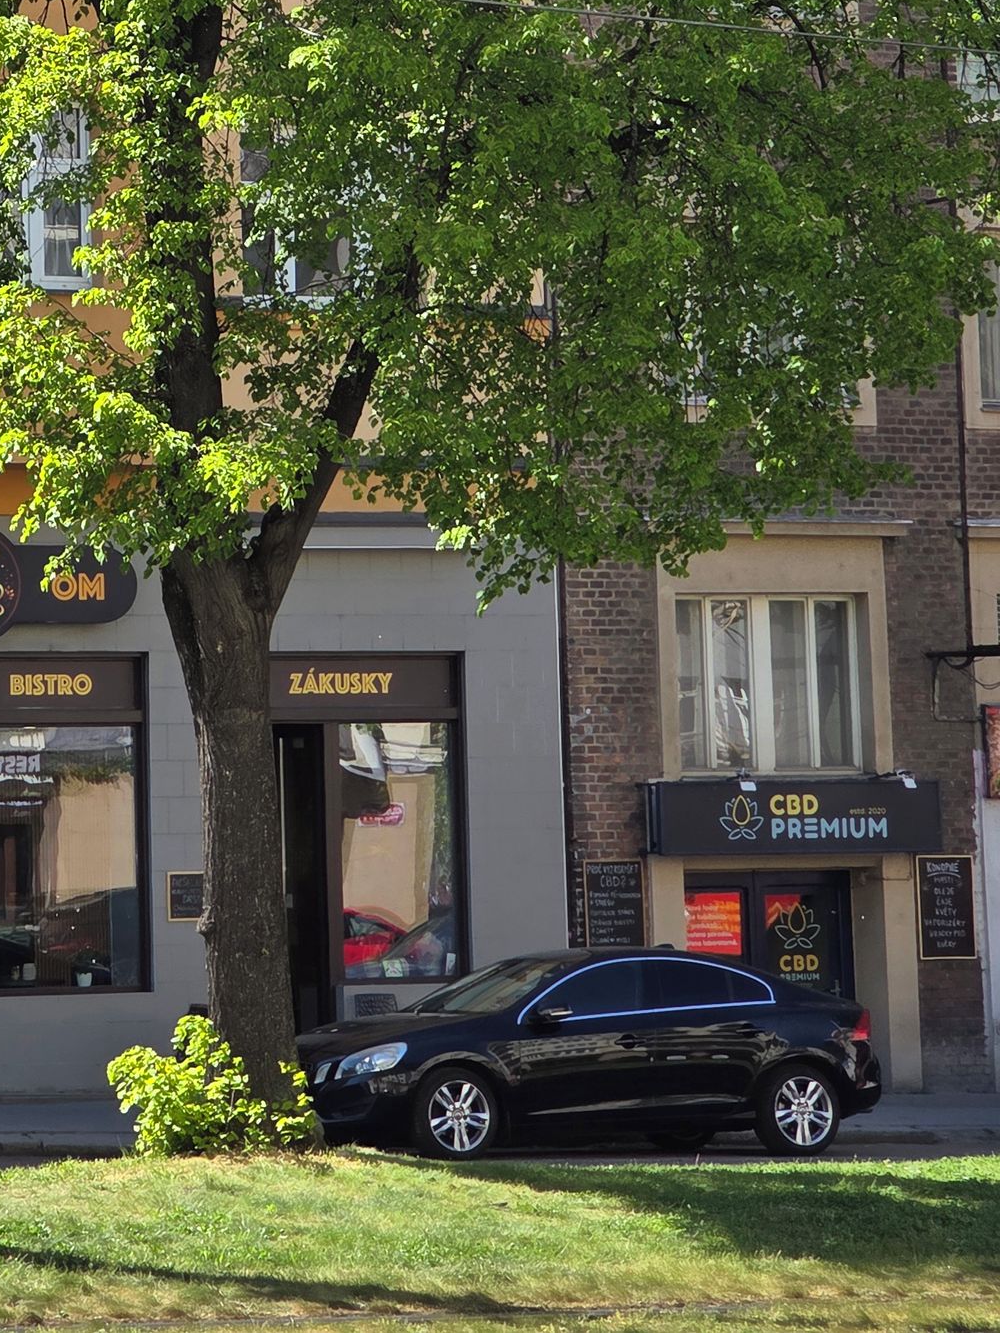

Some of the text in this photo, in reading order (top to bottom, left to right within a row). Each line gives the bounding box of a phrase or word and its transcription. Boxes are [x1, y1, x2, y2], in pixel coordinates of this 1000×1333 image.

[51, 572, 106, 601] OM
[9, 673, 93, 696] BISTRO
[288, 667, 394, 695] ZÁKUSKY
[769, 794, 819, 816] CBD
[868, 807, 887, 815] 2020
[771, 817, 888, 839] PREMIUM
[600, 875, 626, 888] CBD?
[779, 954, 820, 972] CBD
